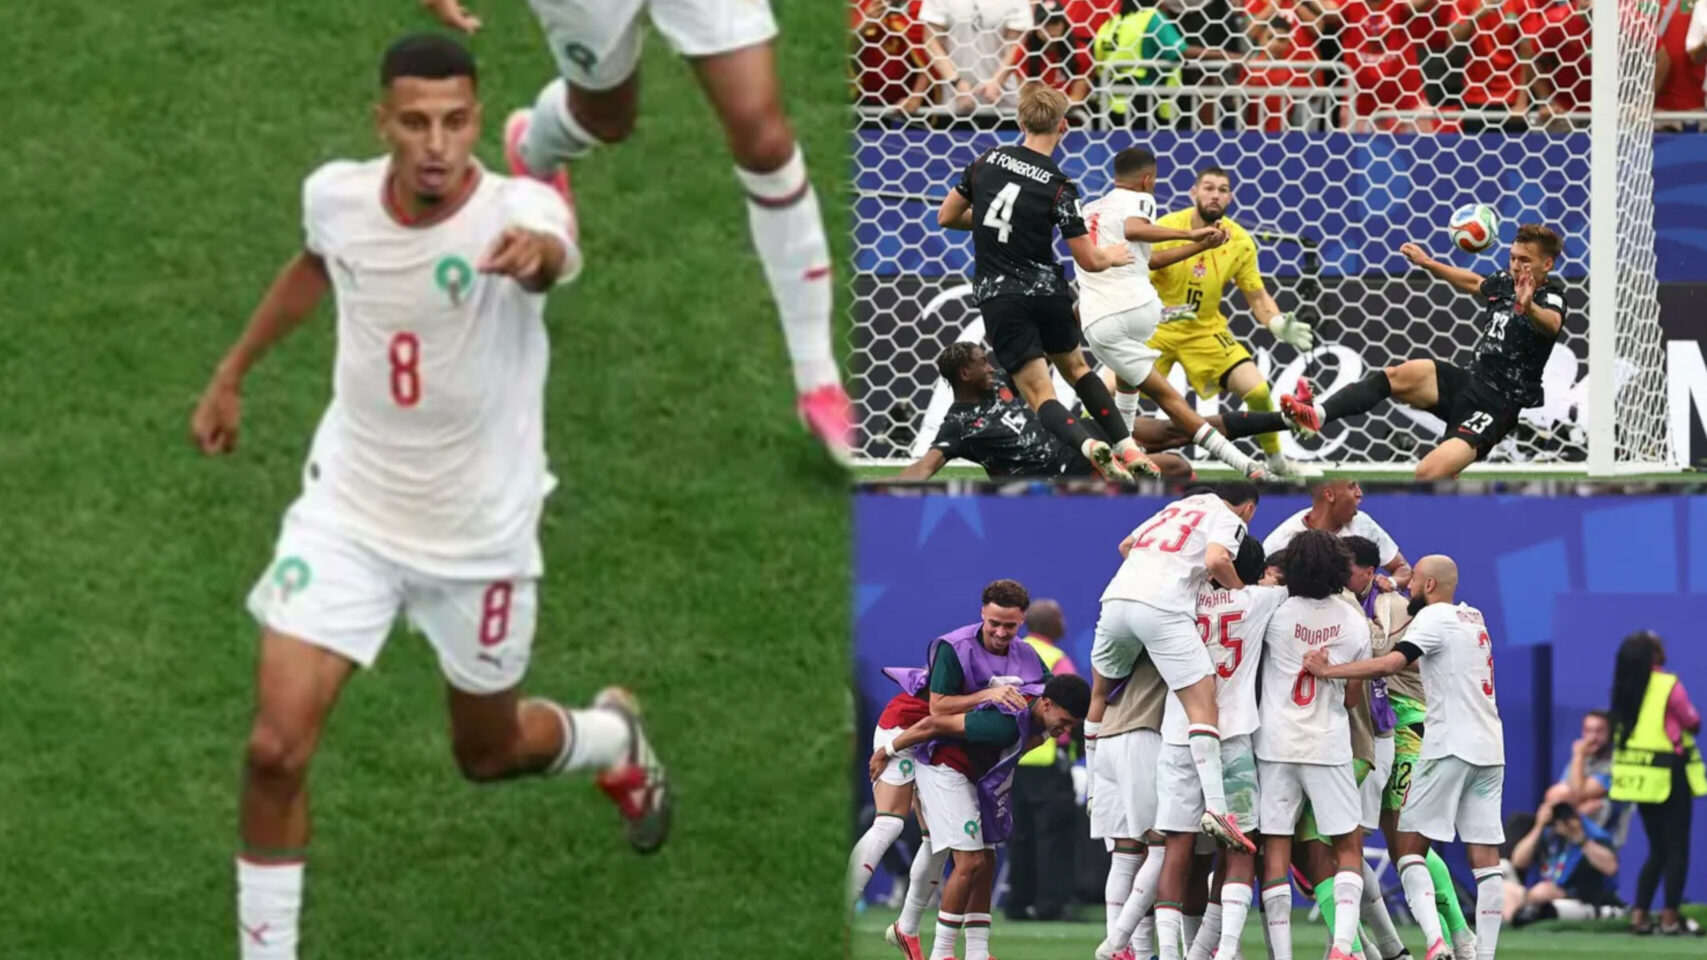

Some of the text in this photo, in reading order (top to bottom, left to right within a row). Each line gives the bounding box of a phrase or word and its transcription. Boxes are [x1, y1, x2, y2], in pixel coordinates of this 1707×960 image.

[996, 153, 1054, 184] FOUGEROLLES
[982, 181, 1021, 243] 4
[1186, 288, 1203, 312] 16
[1213, 332, 1236, 348] 16
[1488, 312, 1509, 340] 23
[389, 332, 420, 407] 8
[1461, 411, 1494, 435] 23
[1132, 507, 1206, 553] 23
[478, 581, 511, 646] 8
[1197, 590, 1235, 609] HAHAL
[1294, 623, 1341, 646] BOUADDI
[1478, 630, 1494, 697] 3
[1391, 761, 1412, 790] 12
